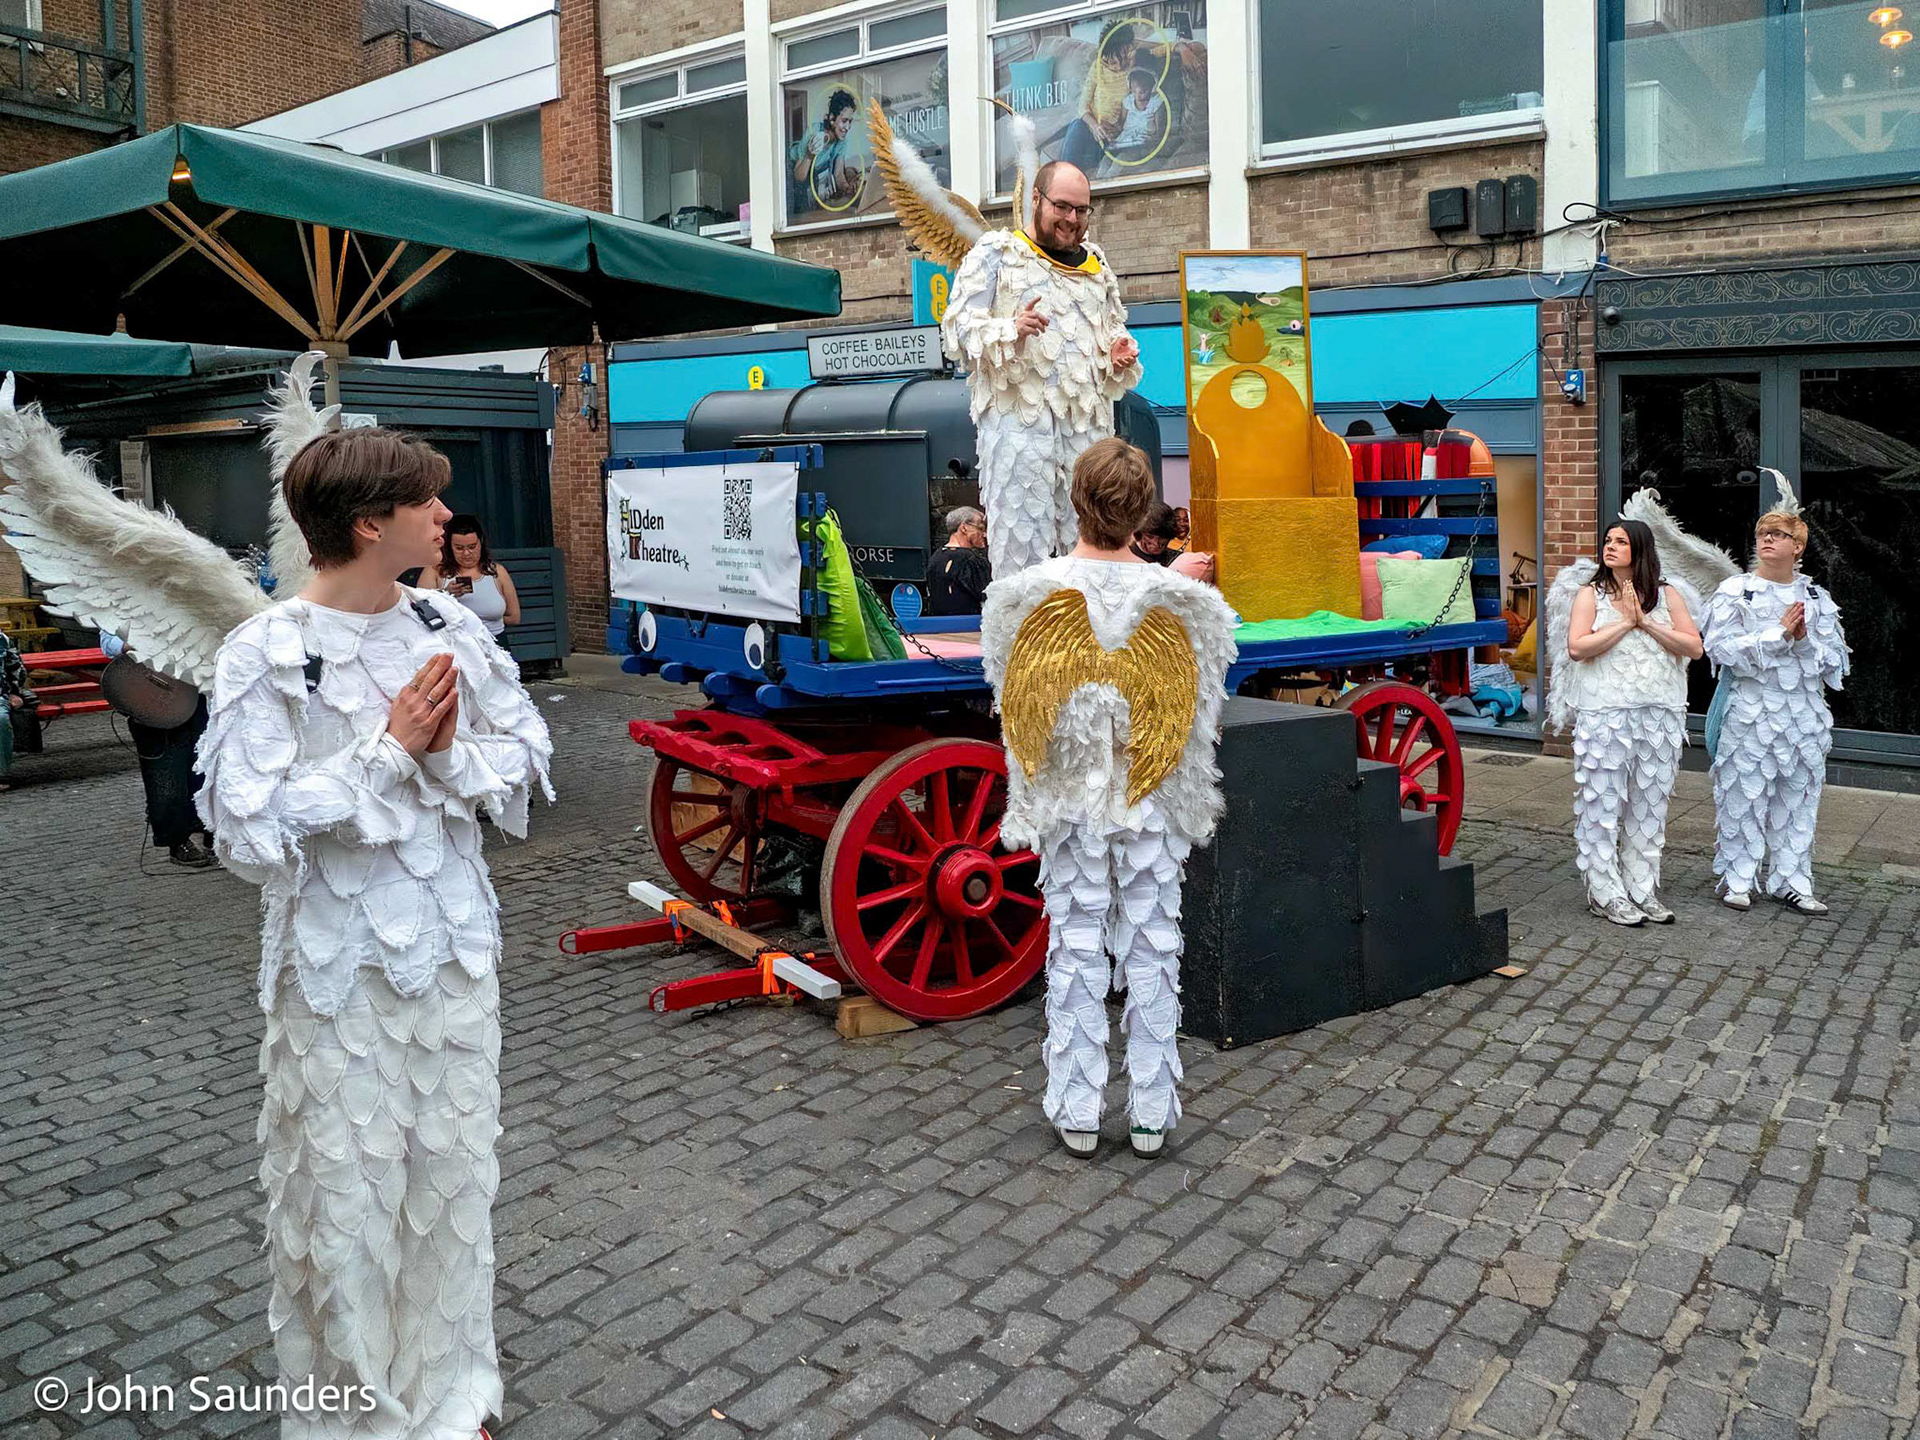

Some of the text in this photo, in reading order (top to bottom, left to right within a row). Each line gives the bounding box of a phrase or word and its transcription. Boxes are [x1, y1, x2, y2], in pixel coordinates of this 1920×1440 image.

[1005, 80, 1067, 112] THINK BIG
[905, 105, 943, 134] HUSTLE
[822, 335, 926, 355] COFFEE BAILEYS
[825, 351, 926, 370] HOT CHOCOLATE
